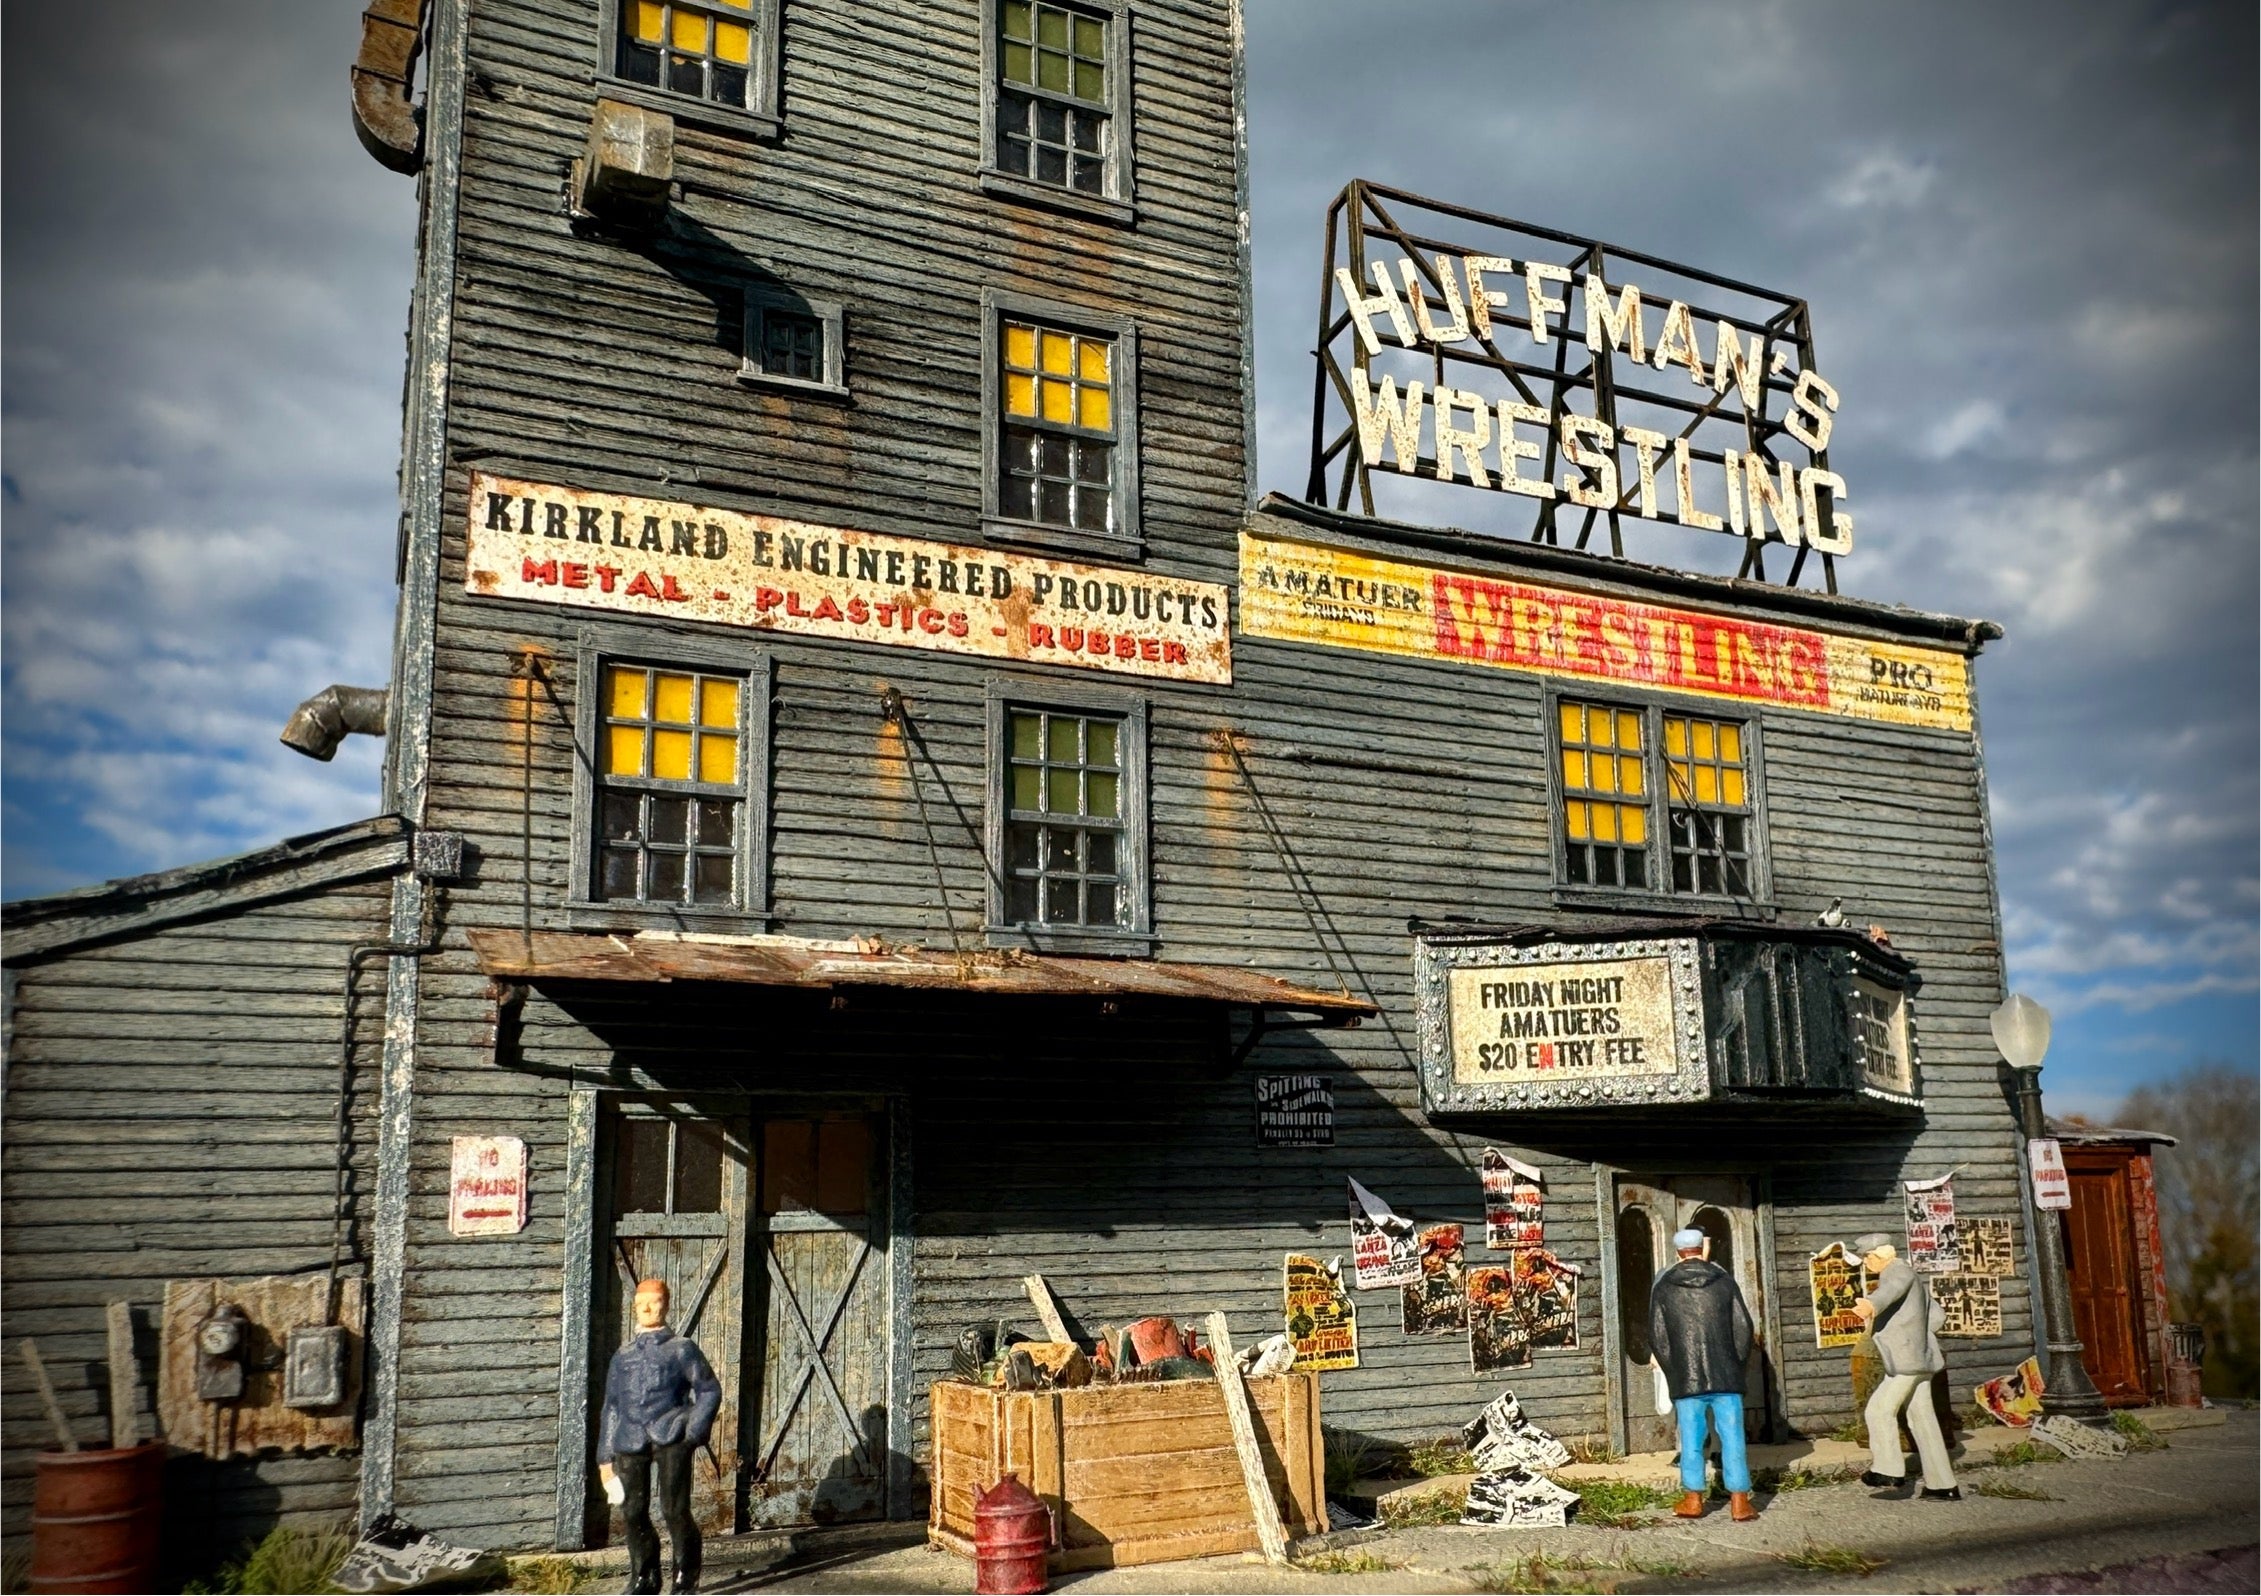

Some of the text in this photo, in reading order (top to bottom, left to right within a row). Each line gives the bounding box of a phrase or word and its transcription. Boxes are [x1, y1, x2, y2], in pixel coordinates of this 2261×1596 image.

[1336, 255, 1839, 454] HUFFMAN'S
[1350, 367, 1853, 557] WRESTLING
[485, 491, 1218, 630] KIRKLAND ENGINEERED PRODUCTS
[1257, 564, 1423, 613] AMATUER
[521, 556, 693, 602] METAL
[755, 585, 969, 638] PLASTICS
[1029, 622, 1188, 666] RUBBER
[1442, 583, 1818, 700] WRESTLING
[1870, 656, 1933, 691] PRO
[1480, 976, 1625, 1009] FRIDAY NIGHT
[1499, 1007, 1621, 1039] AMATUERS
[1478, 1036, 1646, 1074] $20 ENTRY FEE
[1257, 1075, 1321, 1102] SPITTING
[1260, 1111, 1332, 1126] PROHIBITED
